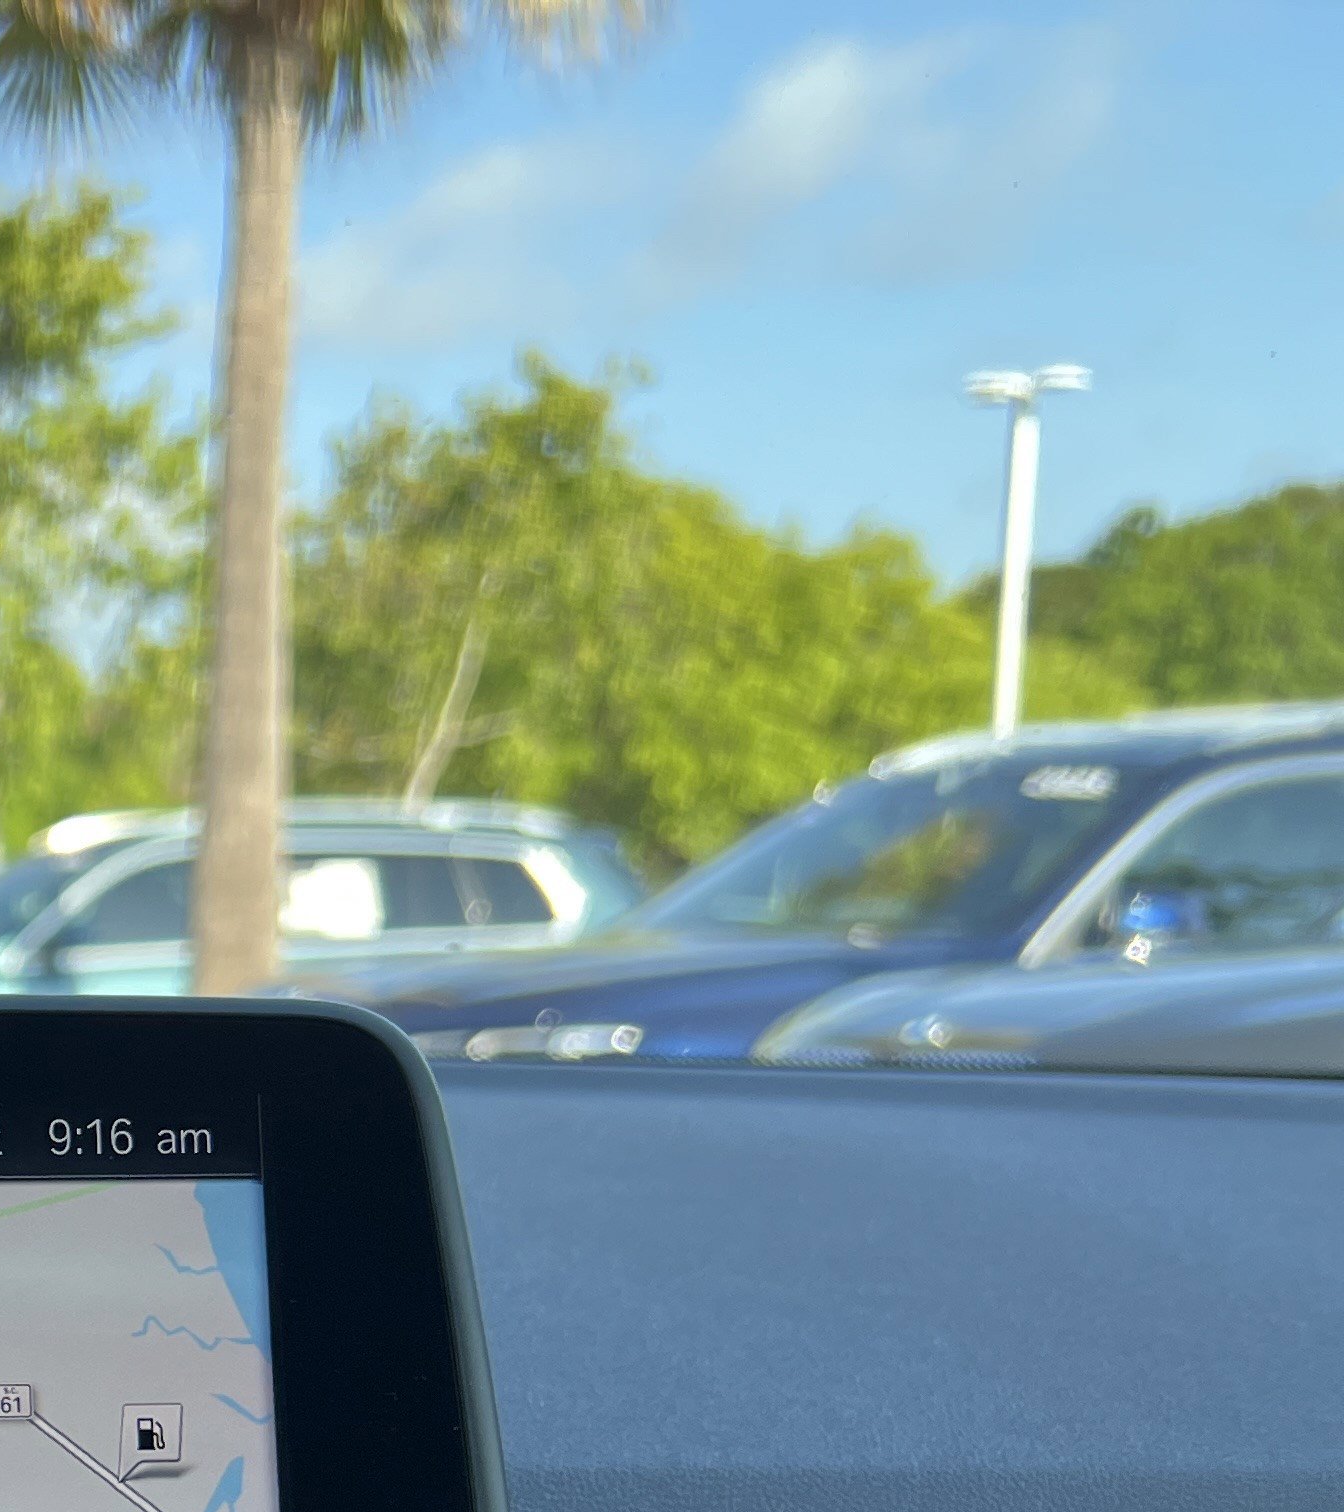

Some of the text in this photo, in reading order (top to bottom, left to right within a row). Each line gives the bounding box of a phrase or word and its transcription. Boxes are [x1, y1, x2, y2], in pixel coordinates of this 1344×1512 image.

[48, 1118, 134, 1156] 9:16
[156, 1128, 212, 1155] am
[0, 1396, 21, 1414] 61
